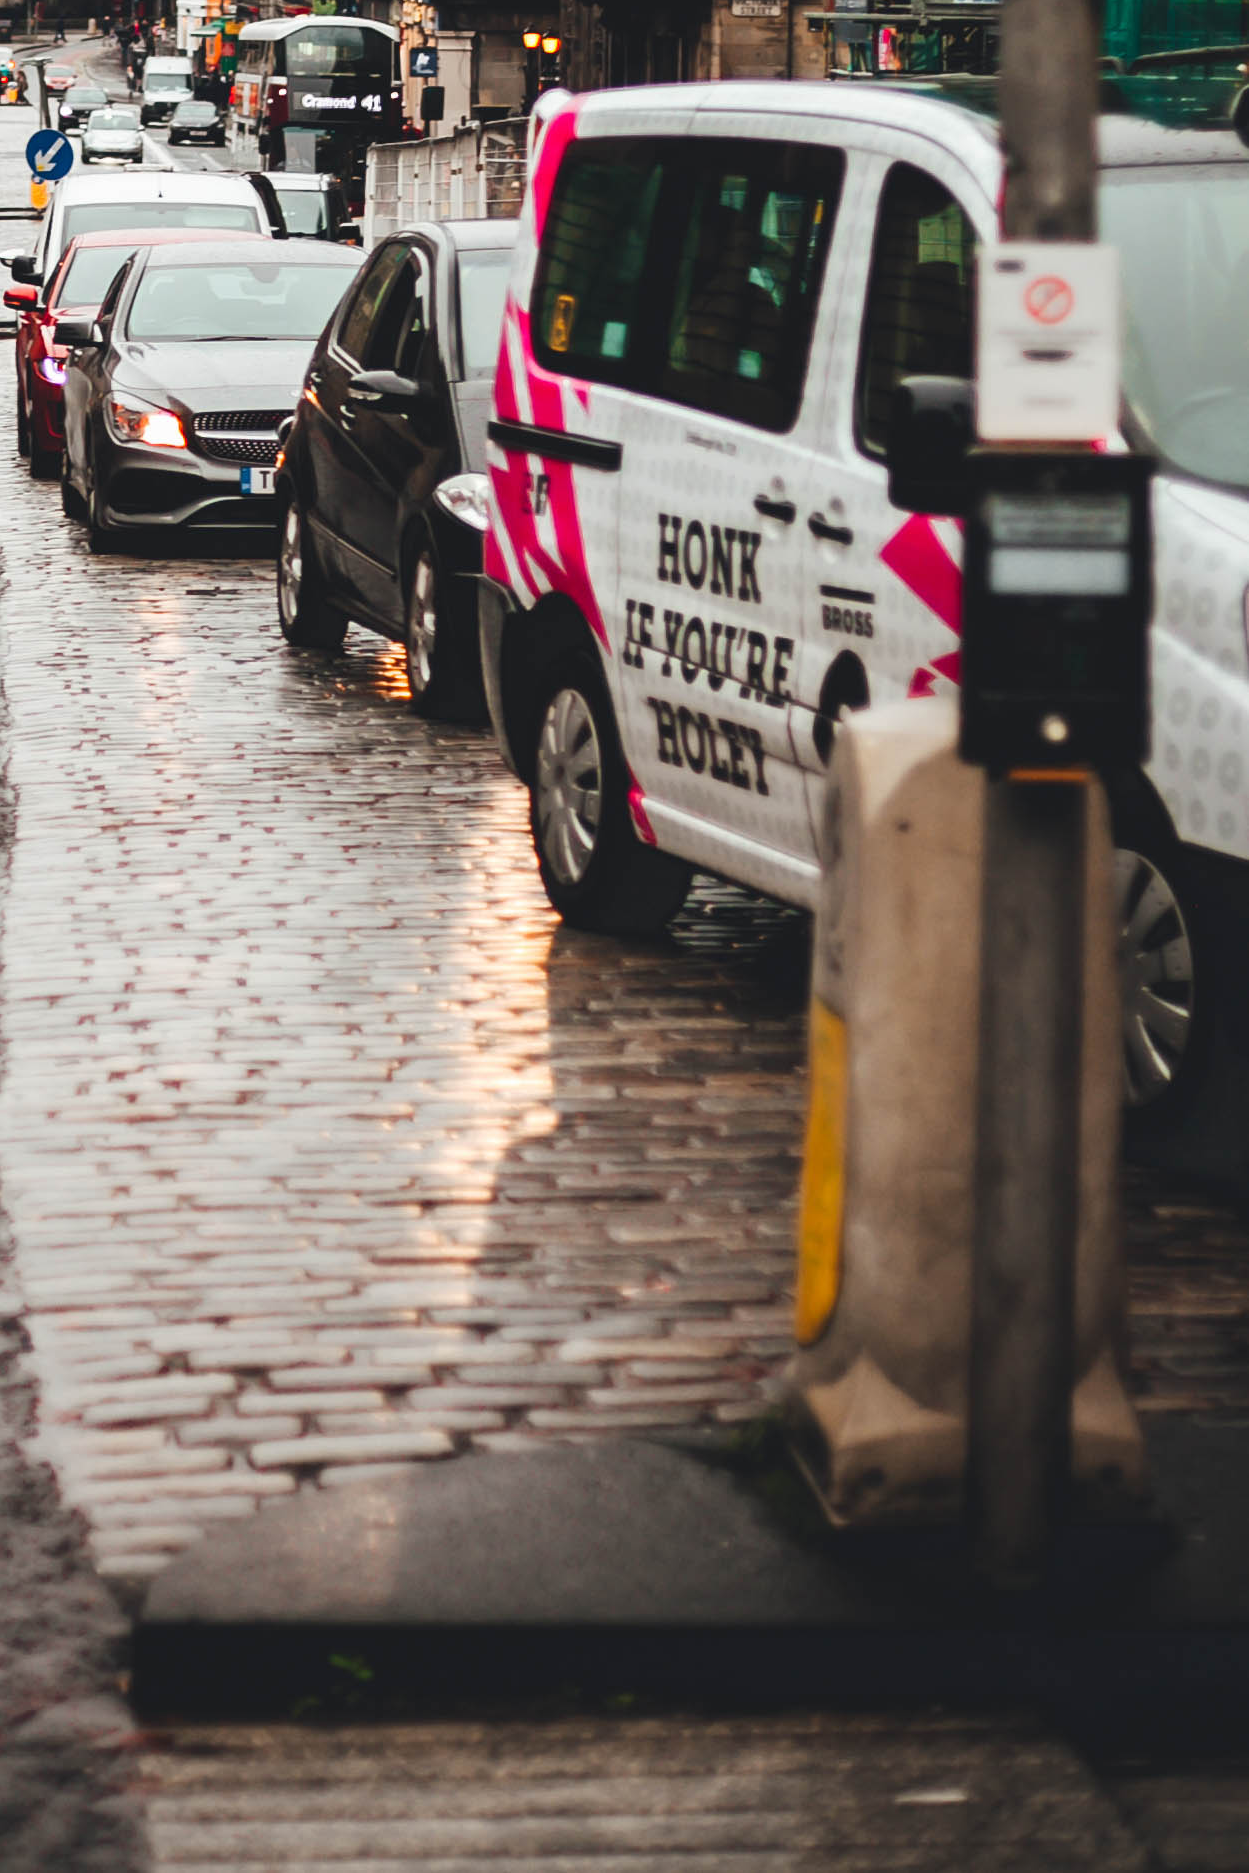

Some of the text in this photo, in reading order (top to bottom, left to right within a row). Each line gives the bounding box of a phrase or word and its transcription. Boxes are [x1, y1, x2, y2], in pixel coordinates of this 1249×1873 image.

[302, 93, 382, 112] Cramond 41
[657, 512, 761, 604] HONK
[623, 598, 794, 709] IF YOU'RE
[822, 604, 873, 639] BROSS
[647, 696, 769, 797] HOLEY
